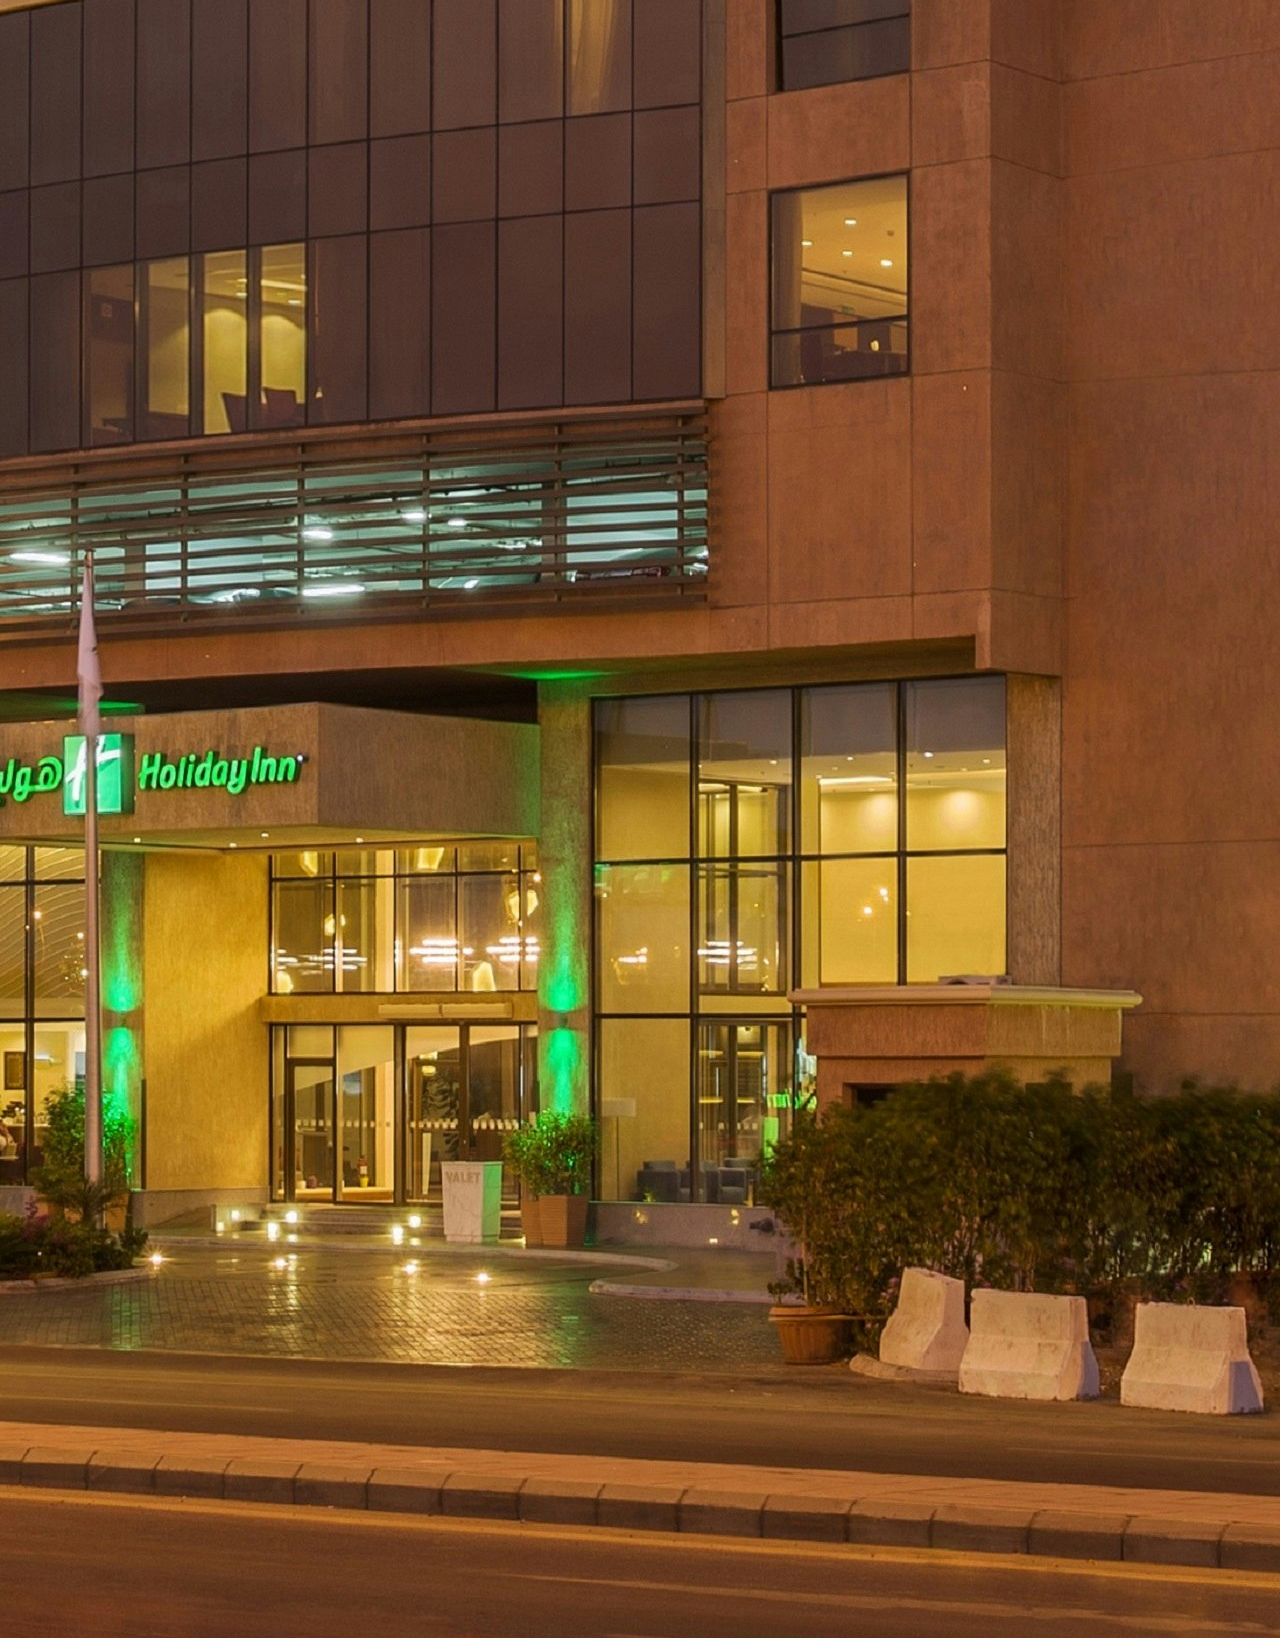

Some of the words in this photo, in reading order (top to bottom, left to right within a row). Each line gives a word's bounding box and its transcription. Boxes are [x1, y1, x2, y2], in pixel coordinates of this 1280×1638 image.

[138, 750, 248, 795] Holiday
[250, 745, 297, 784] Inn
[445, 1171, 480, 1183] VALET
